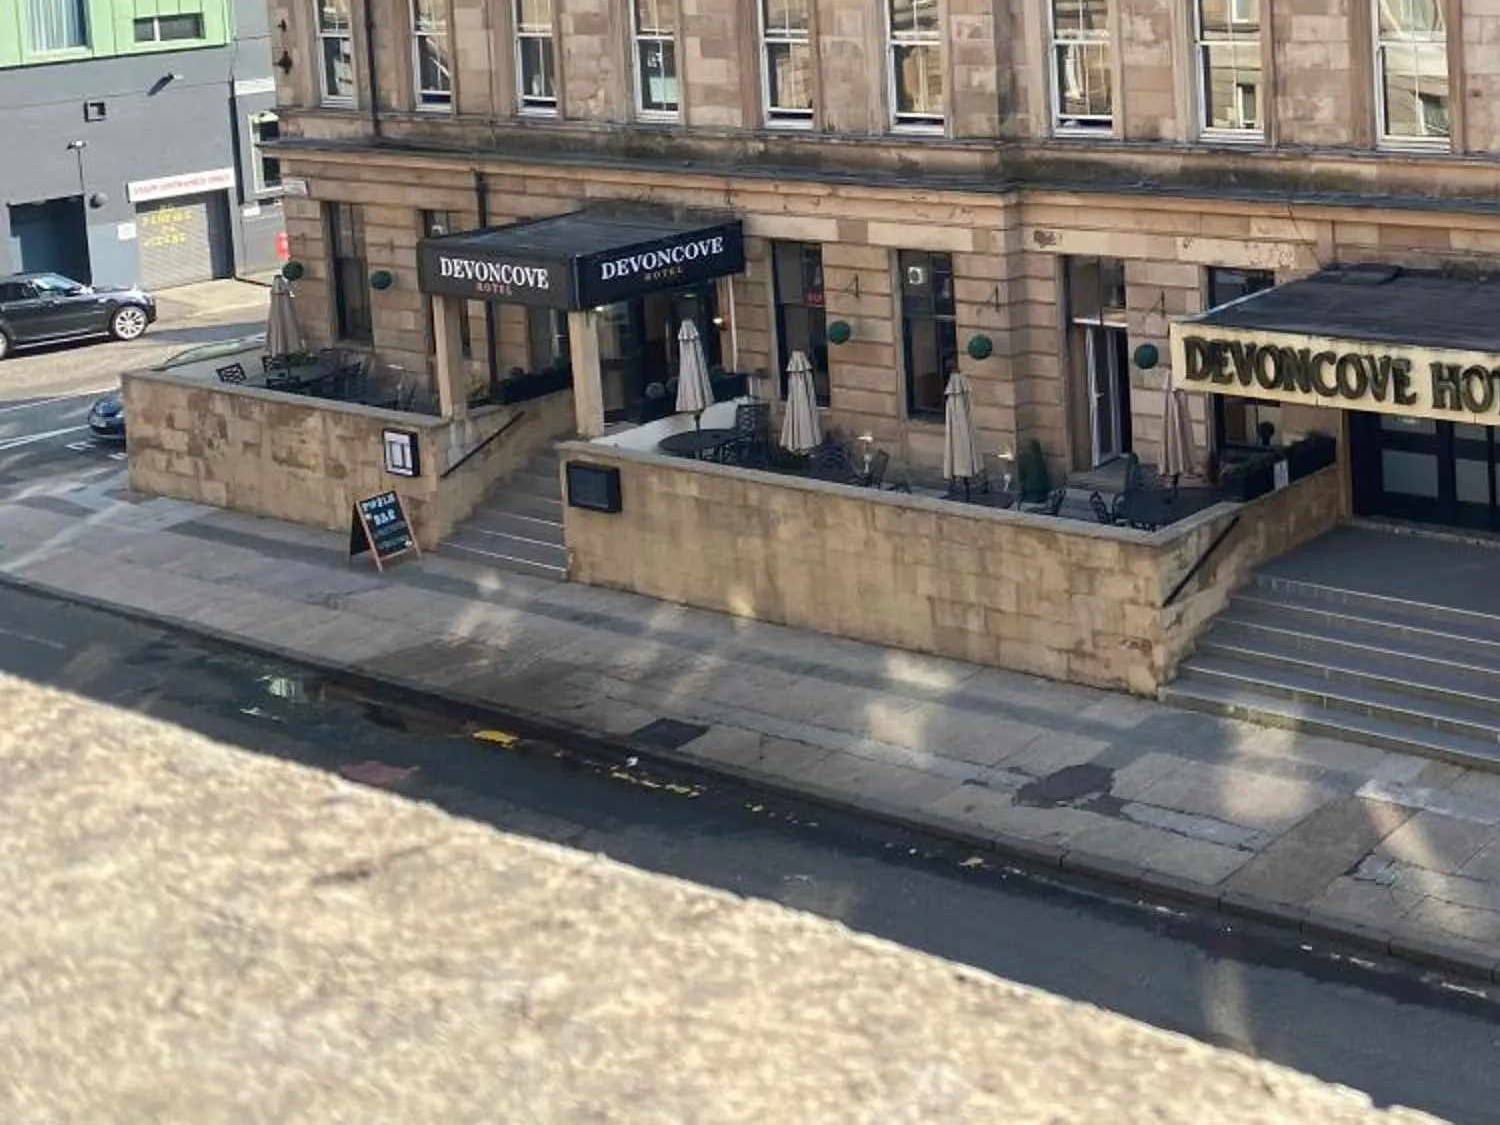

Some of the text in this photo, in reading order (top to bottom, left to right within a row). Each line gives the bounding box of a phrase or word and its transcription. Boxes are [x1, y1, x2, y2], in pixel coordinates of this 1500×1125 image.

[440, 256, 549, 290] DEVONCOVE
[601, 236, 724, 280] DEVONCOVE
[644, 265, 684, 281] HOTEL
[475, 282, 513, 296] HOTEL
[1182, 336, 1417, 406] DEVONCOVE
